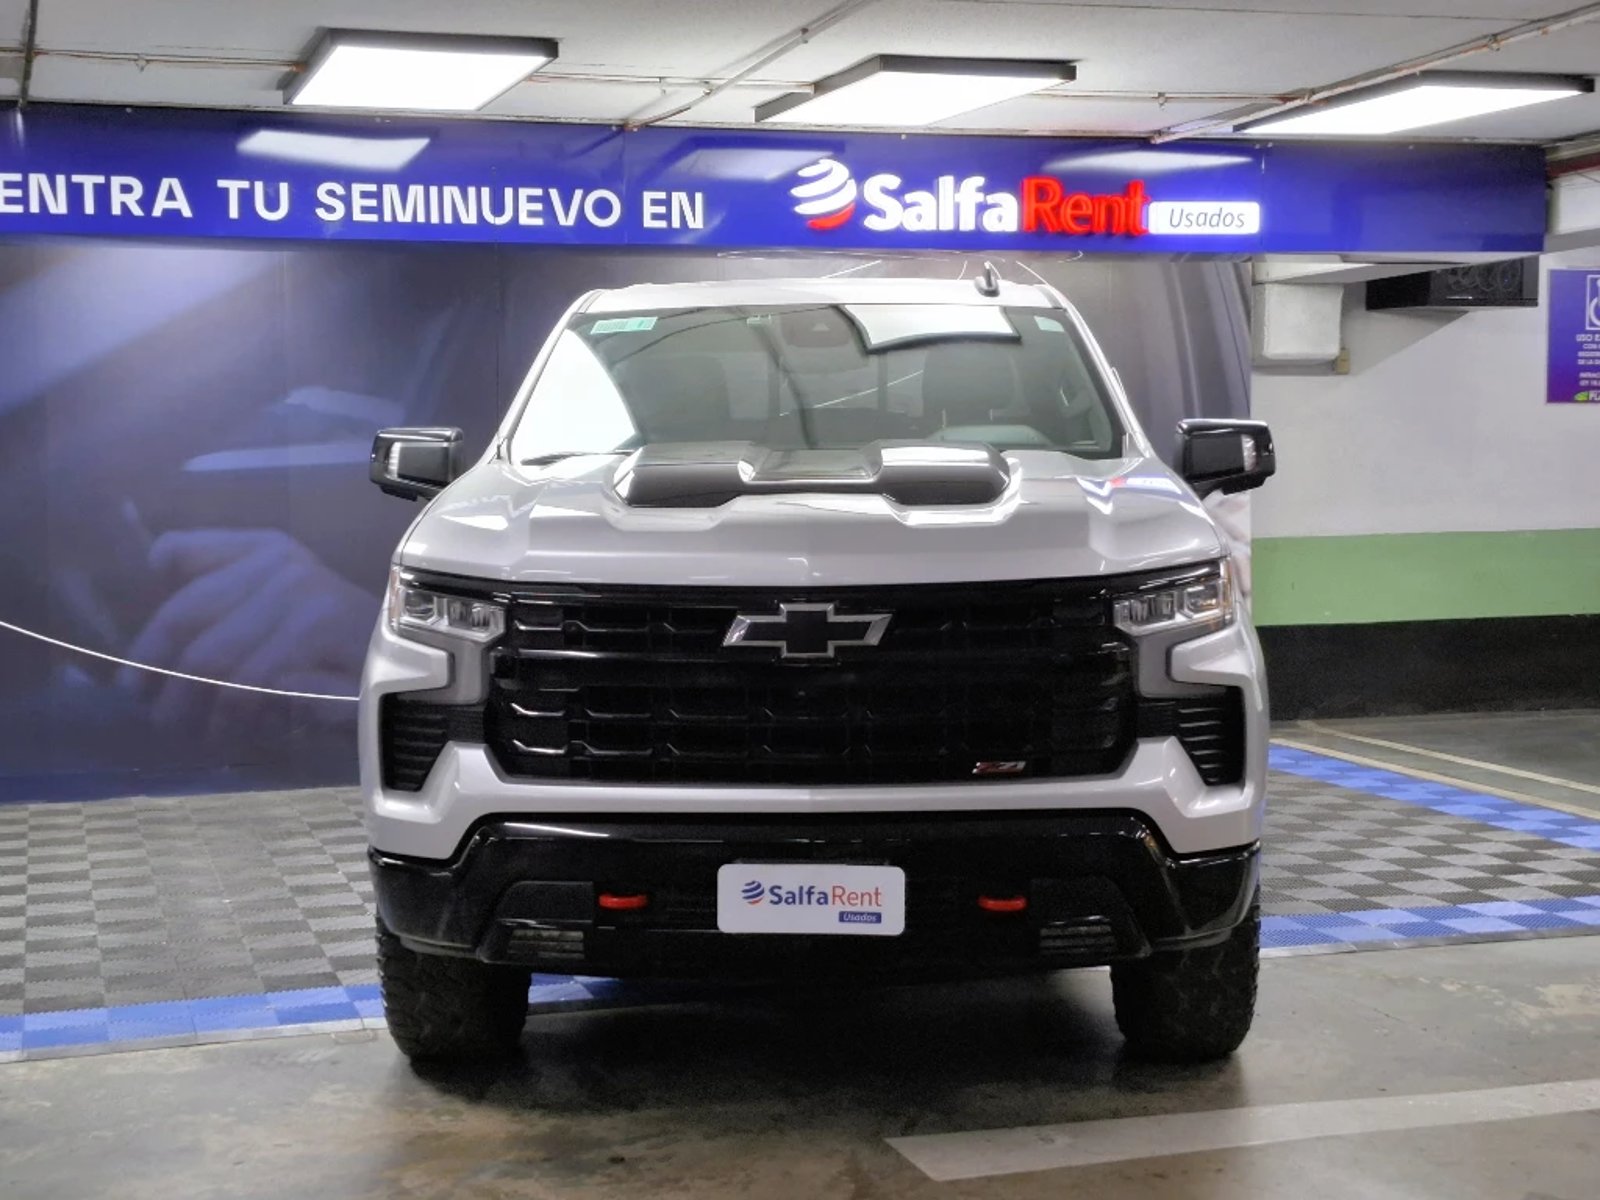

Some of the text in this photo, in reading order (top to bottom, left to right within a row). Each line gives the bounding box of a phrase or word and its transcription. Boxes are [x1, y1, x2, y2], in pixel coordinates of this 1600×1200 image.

[0, 173, 705, 230] ENTRA TU SEMINUEVO EN
[863, 174, 1245, 236] SalfaRent Usados
[768, 885, 882, 907] SalfaRent
[843, 912, 878, 923] Usados
